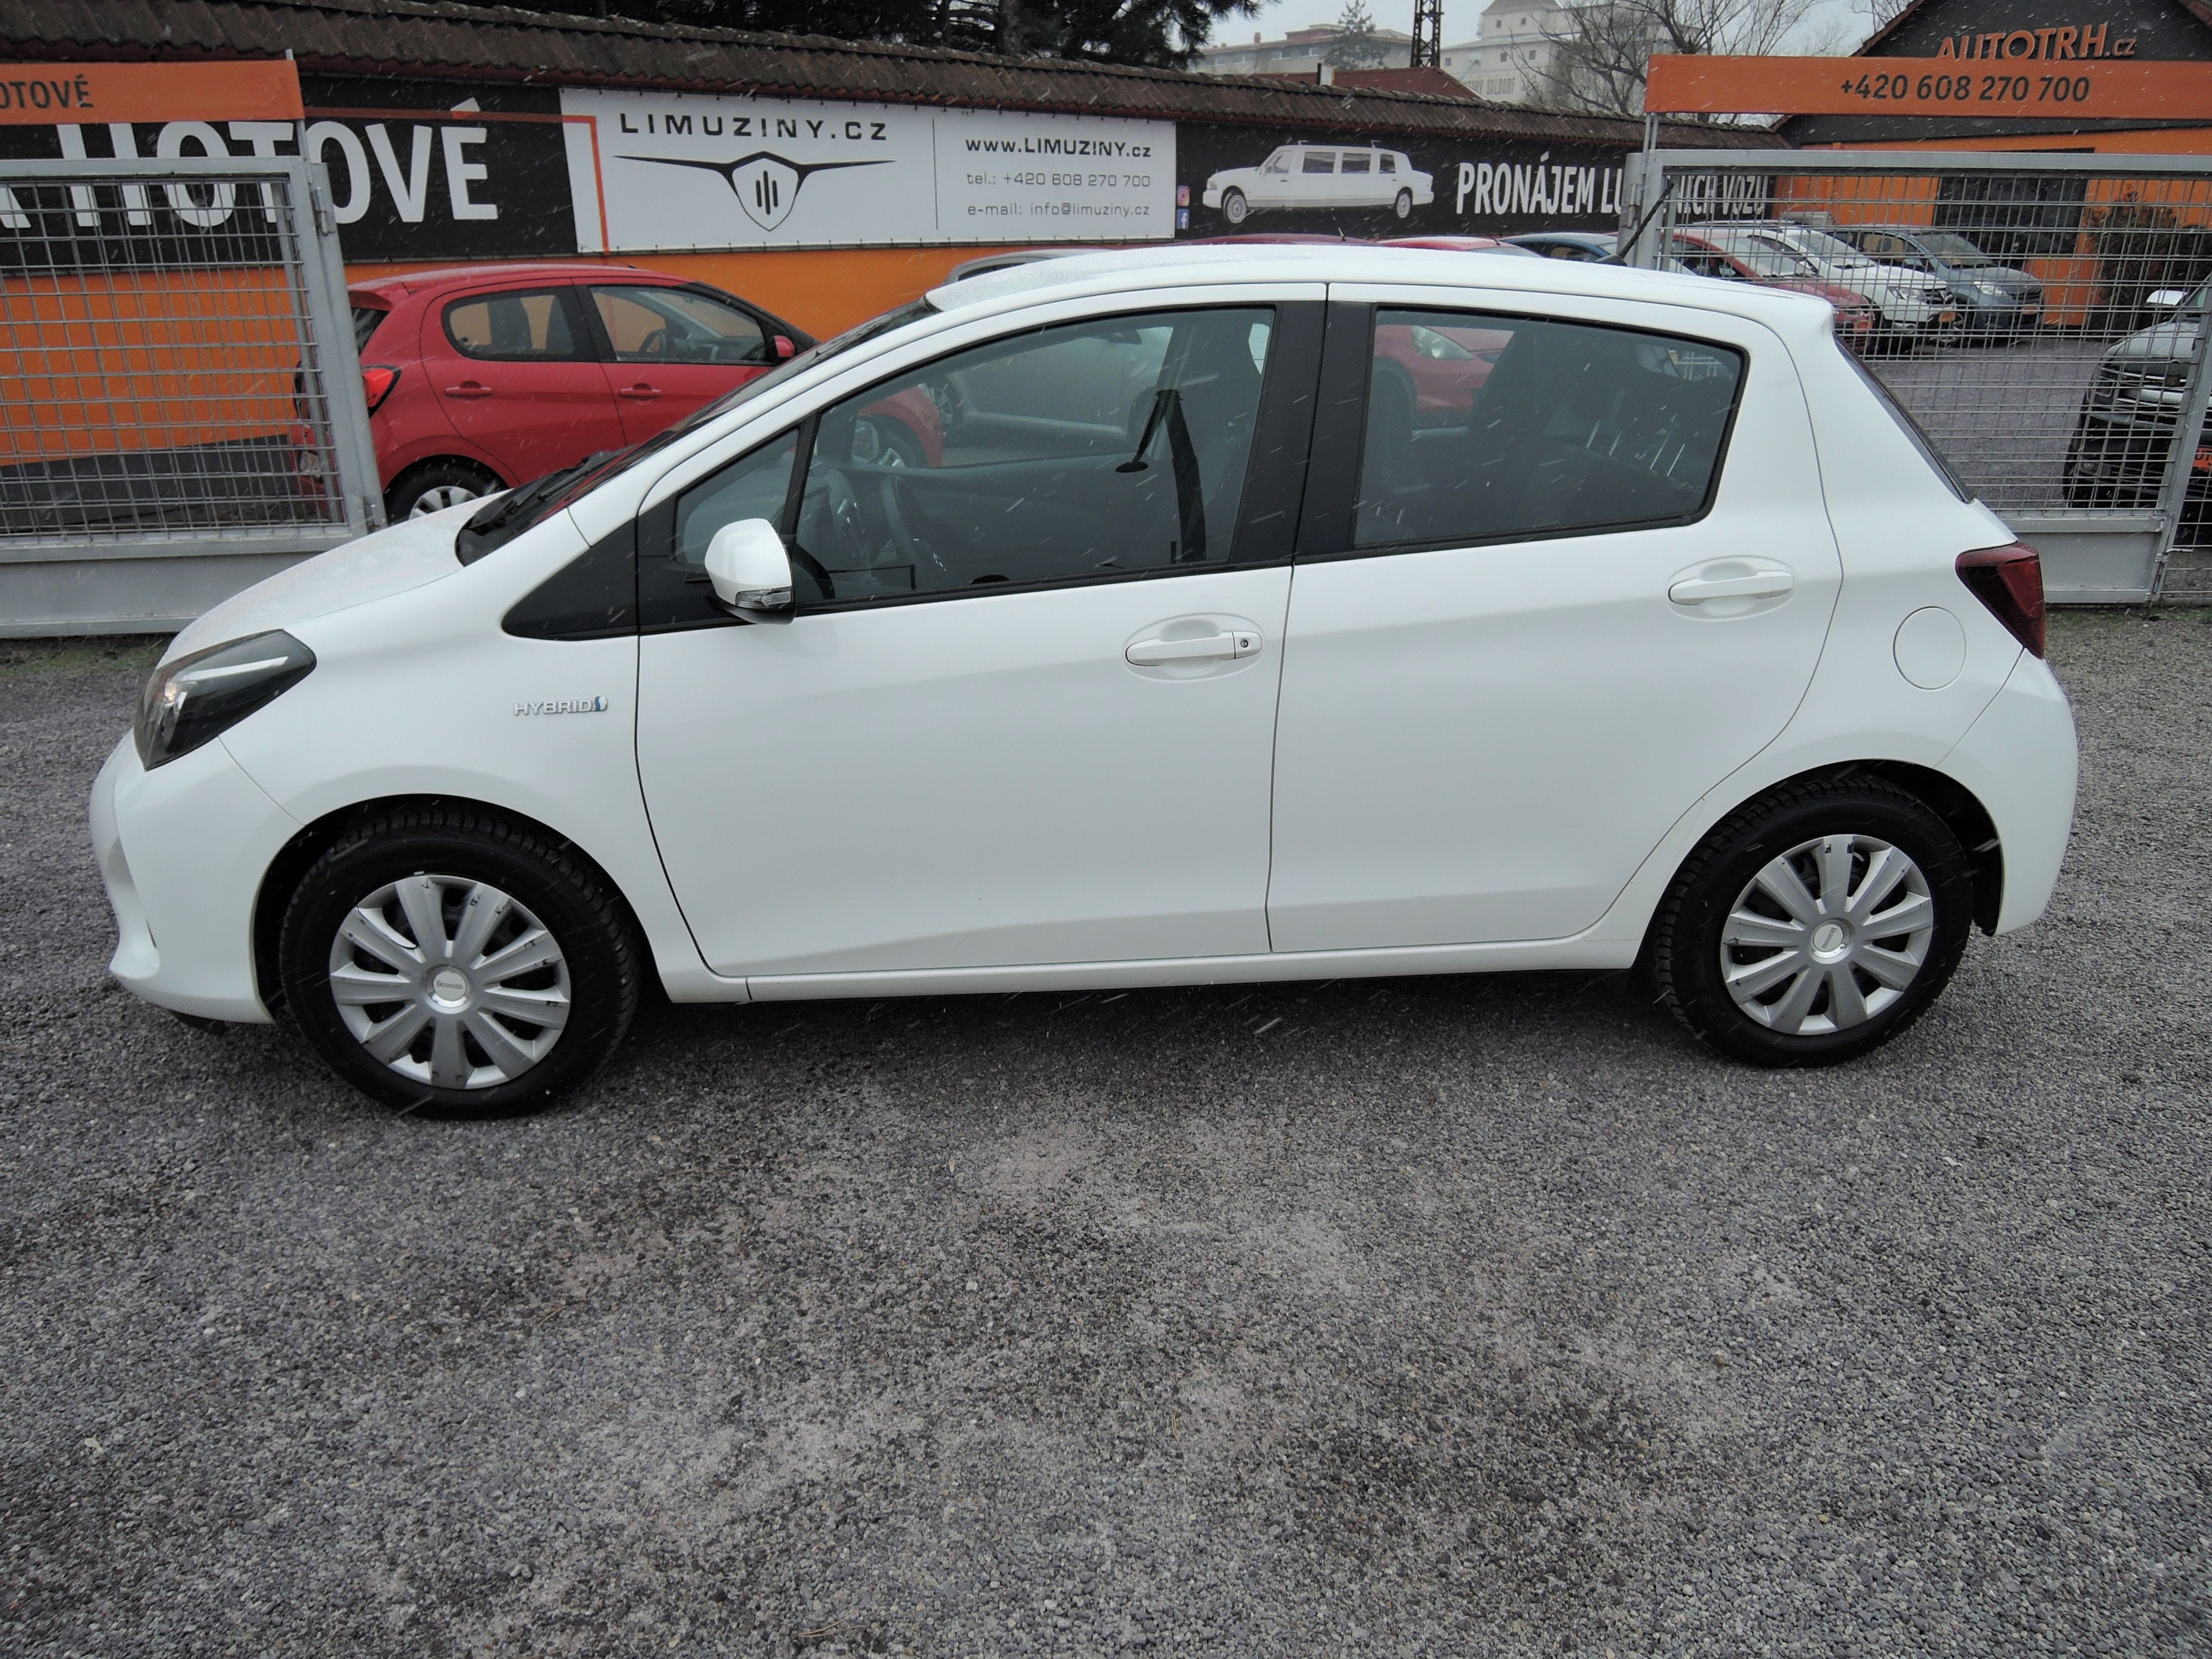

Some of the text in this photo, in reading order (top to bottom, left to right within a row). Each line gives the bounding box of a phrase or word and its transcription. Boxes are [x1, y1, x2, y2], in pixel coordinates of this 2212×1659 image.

[1841, 74, 2090, 102] +420 608 270 700
[620, 113, 886, 140] LIMUZINY.CZ
[966, 137, 1151, 158] www.LIMUZINY.cz
[967, 172, 1150, 187] tel.: +420 608 270 700
[1456, 151, 1595, 215] PRONÁJEM
[968, 203, 1150, 217] e-mail: info@limuziny.cz
[513, 699, 593, 716] HYBRID
